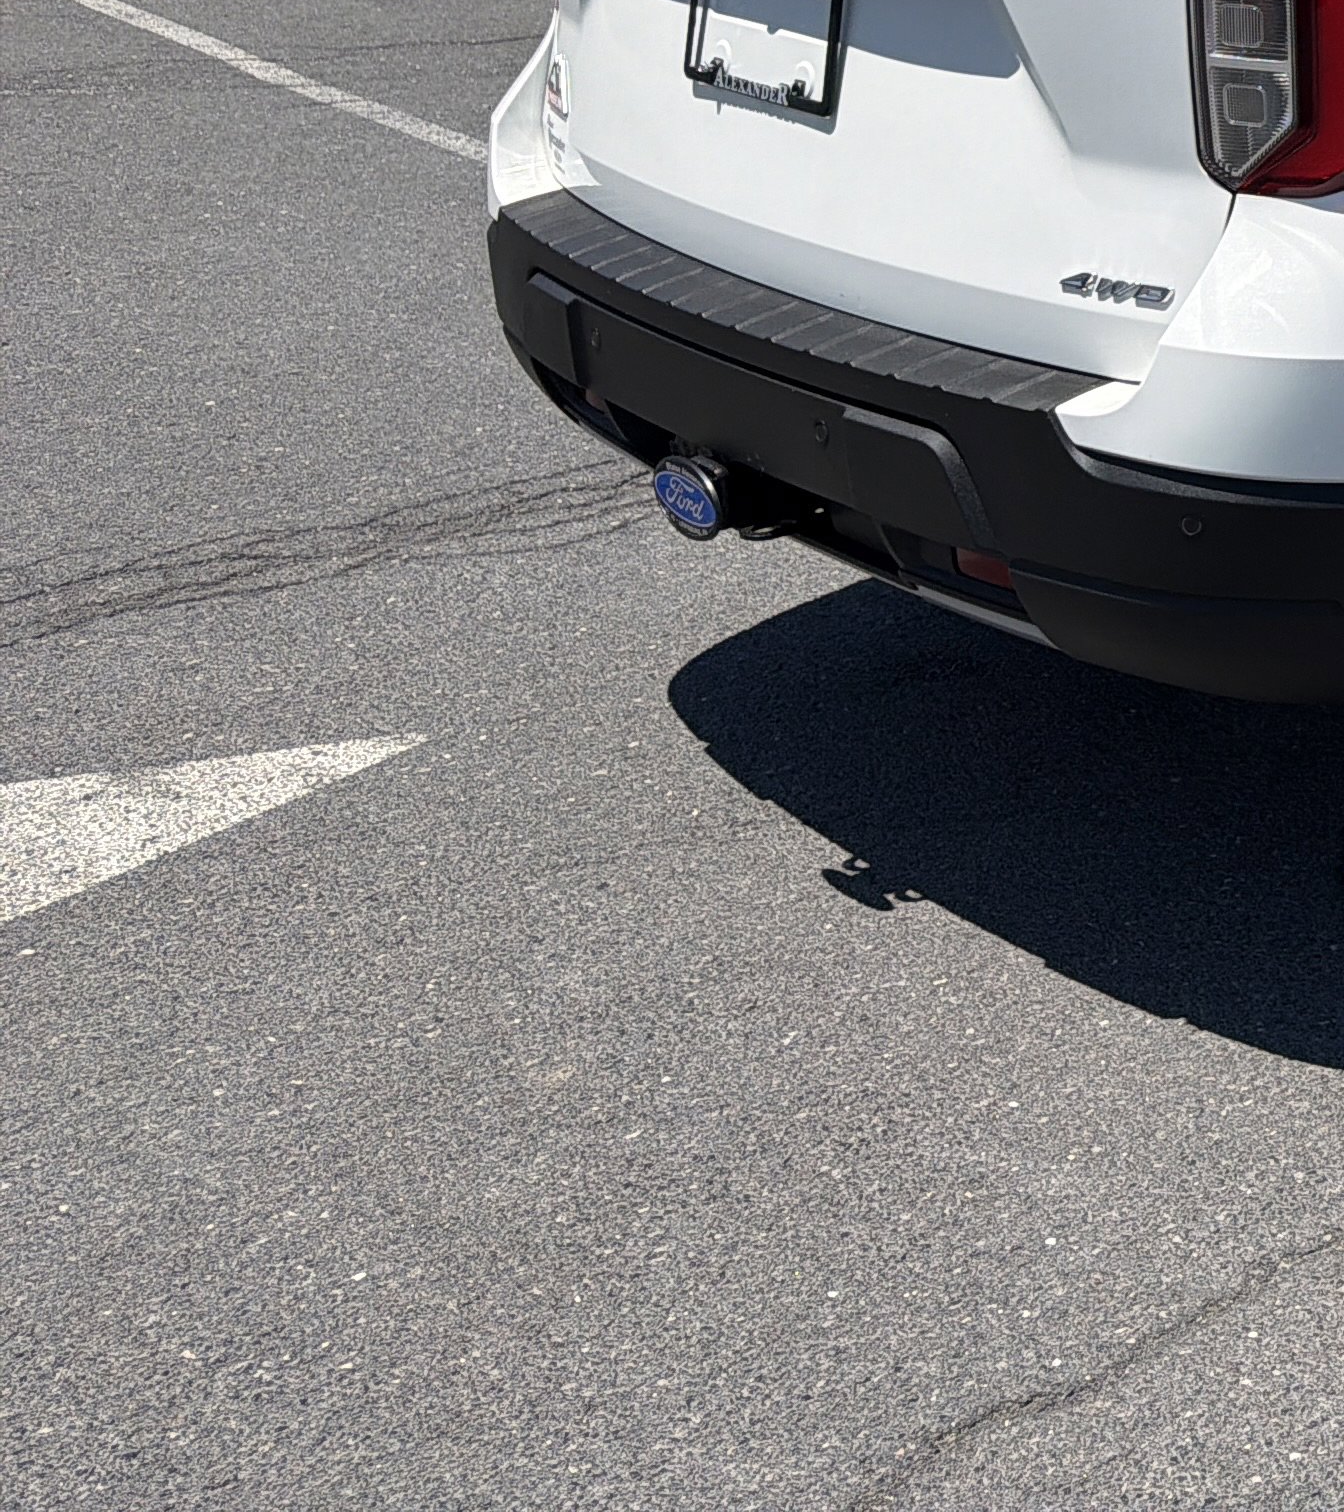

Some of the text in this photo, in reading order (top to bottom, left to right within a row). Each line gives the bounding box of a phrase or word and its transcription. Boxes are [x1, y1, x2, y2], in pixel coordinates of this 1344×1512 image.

[713, 67, 790, 106] ALEXANDER
[1059, 272, 1176, 309] 4WD
[666, 476, 705, 521] Ford
